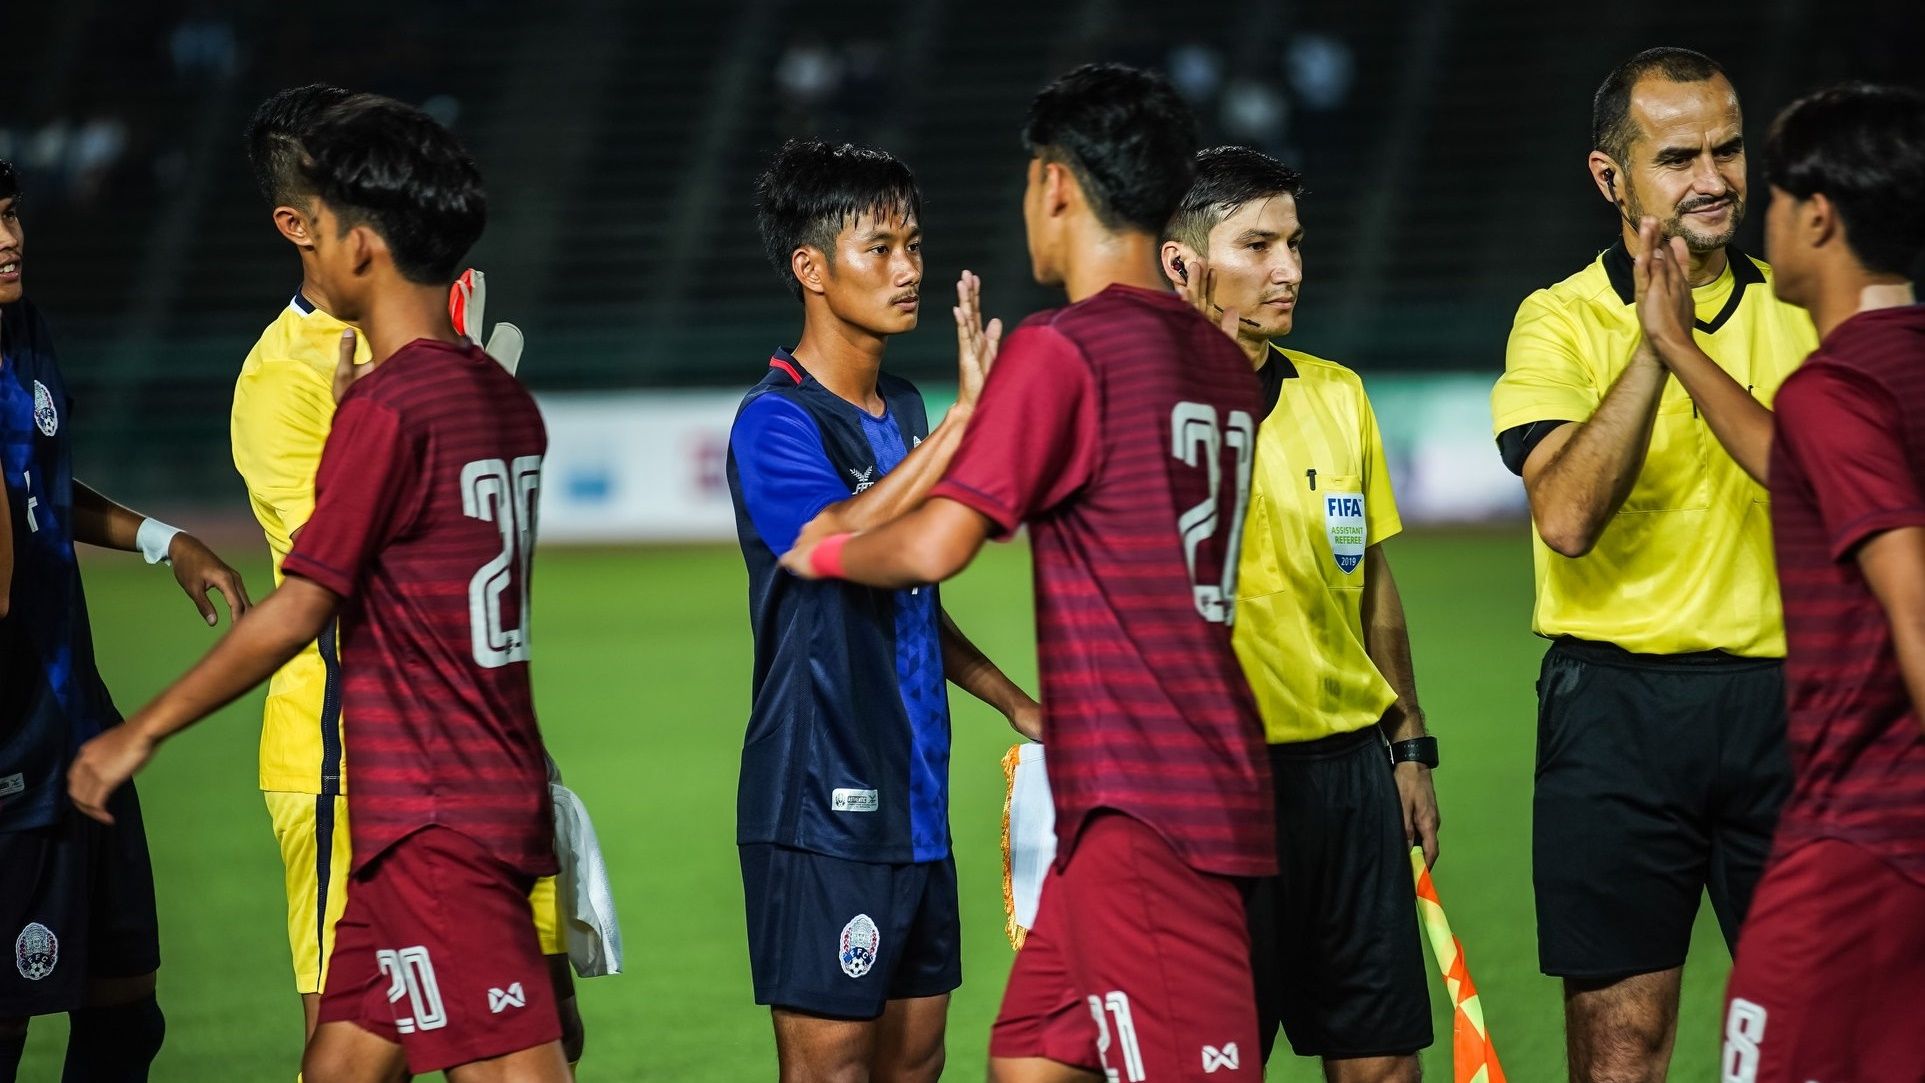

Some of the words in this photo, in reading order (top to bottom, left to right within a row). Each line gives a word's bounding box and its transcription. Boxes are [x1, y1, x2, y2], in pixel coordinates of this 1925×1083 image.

[1171, 401, 1254, 626] 21
[1328, 498, 1362, 517] FIFA
[1331, 526, 1363, 535] ASSISTANT
[460, 455, 541, 669] 20
[1334, 536, 1362, 545] REFEREE
[1341, 556, 1357, 567] 2019
[376, 945, 447, 1034] 20
[1087, 990, 1146, 1083] 21
